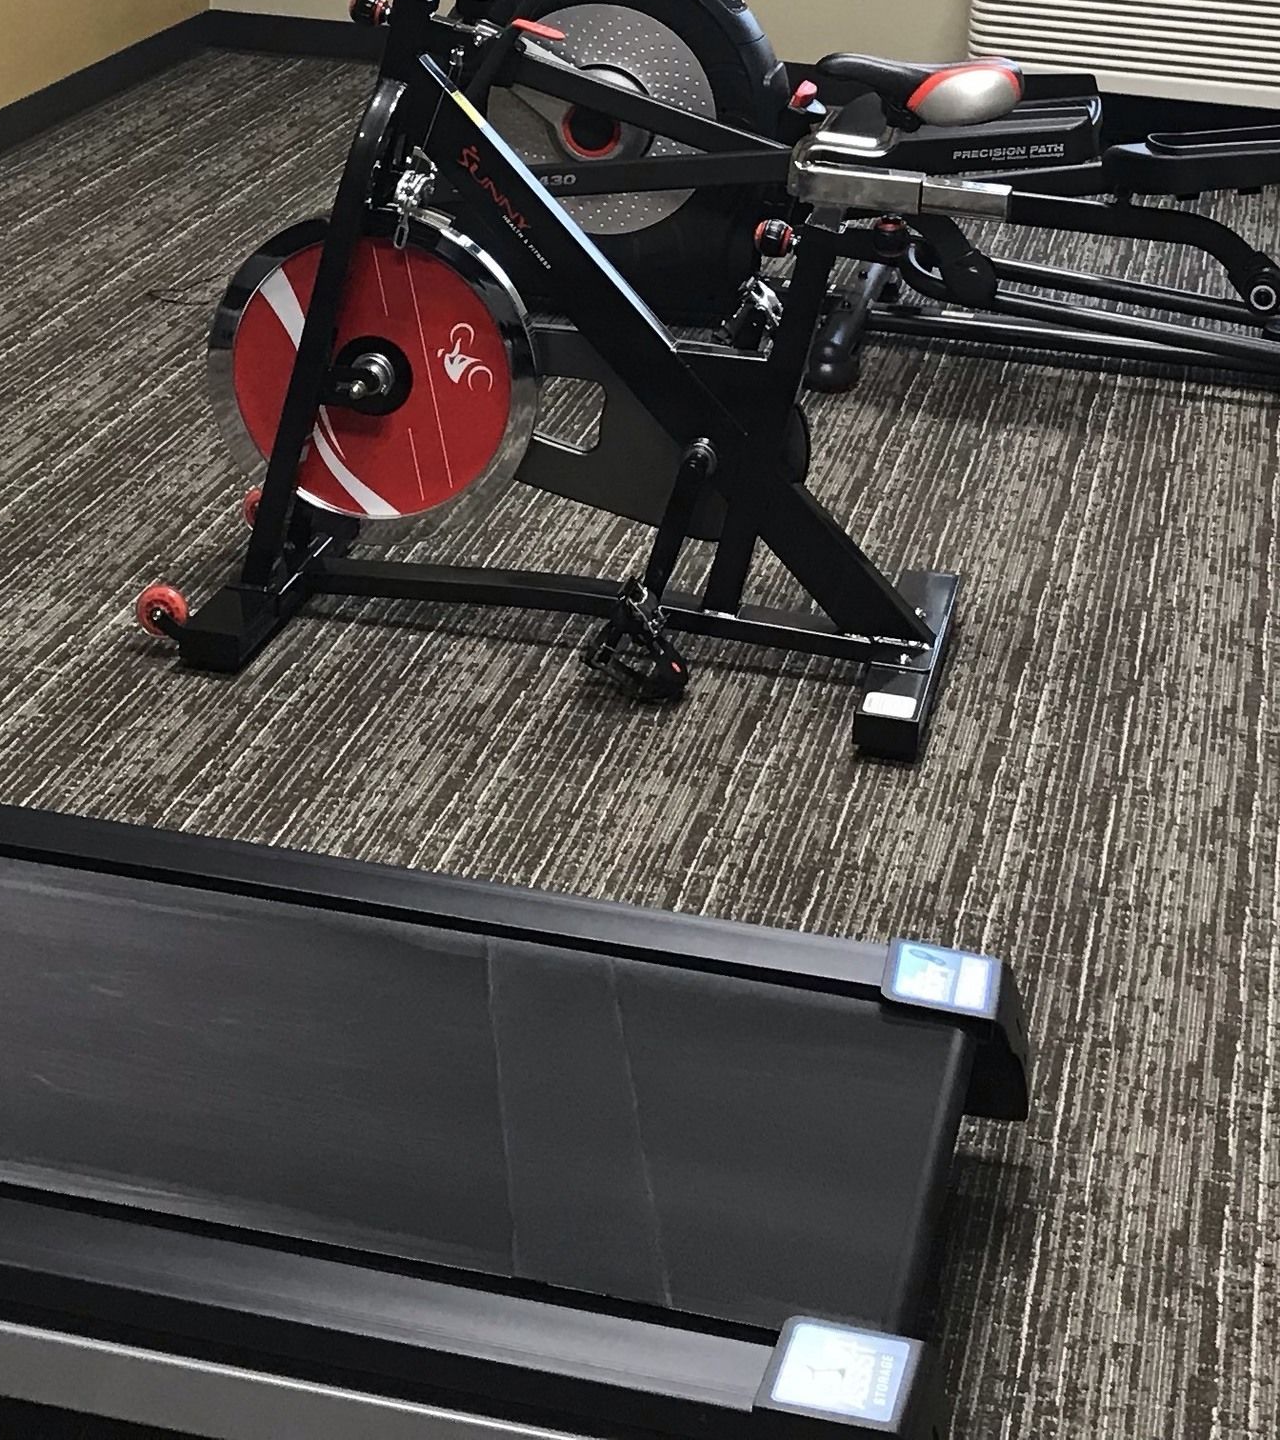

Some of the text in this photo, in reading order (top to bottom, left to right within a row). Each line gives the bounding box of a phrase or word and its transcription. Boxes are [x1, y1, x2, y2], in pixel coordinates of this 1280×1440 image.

[953, 143, 1064, 160] PRECISION PATH
[528, 244, 552, 270] FITNESS
[873, 1353, 895, 1406] STORAGE
